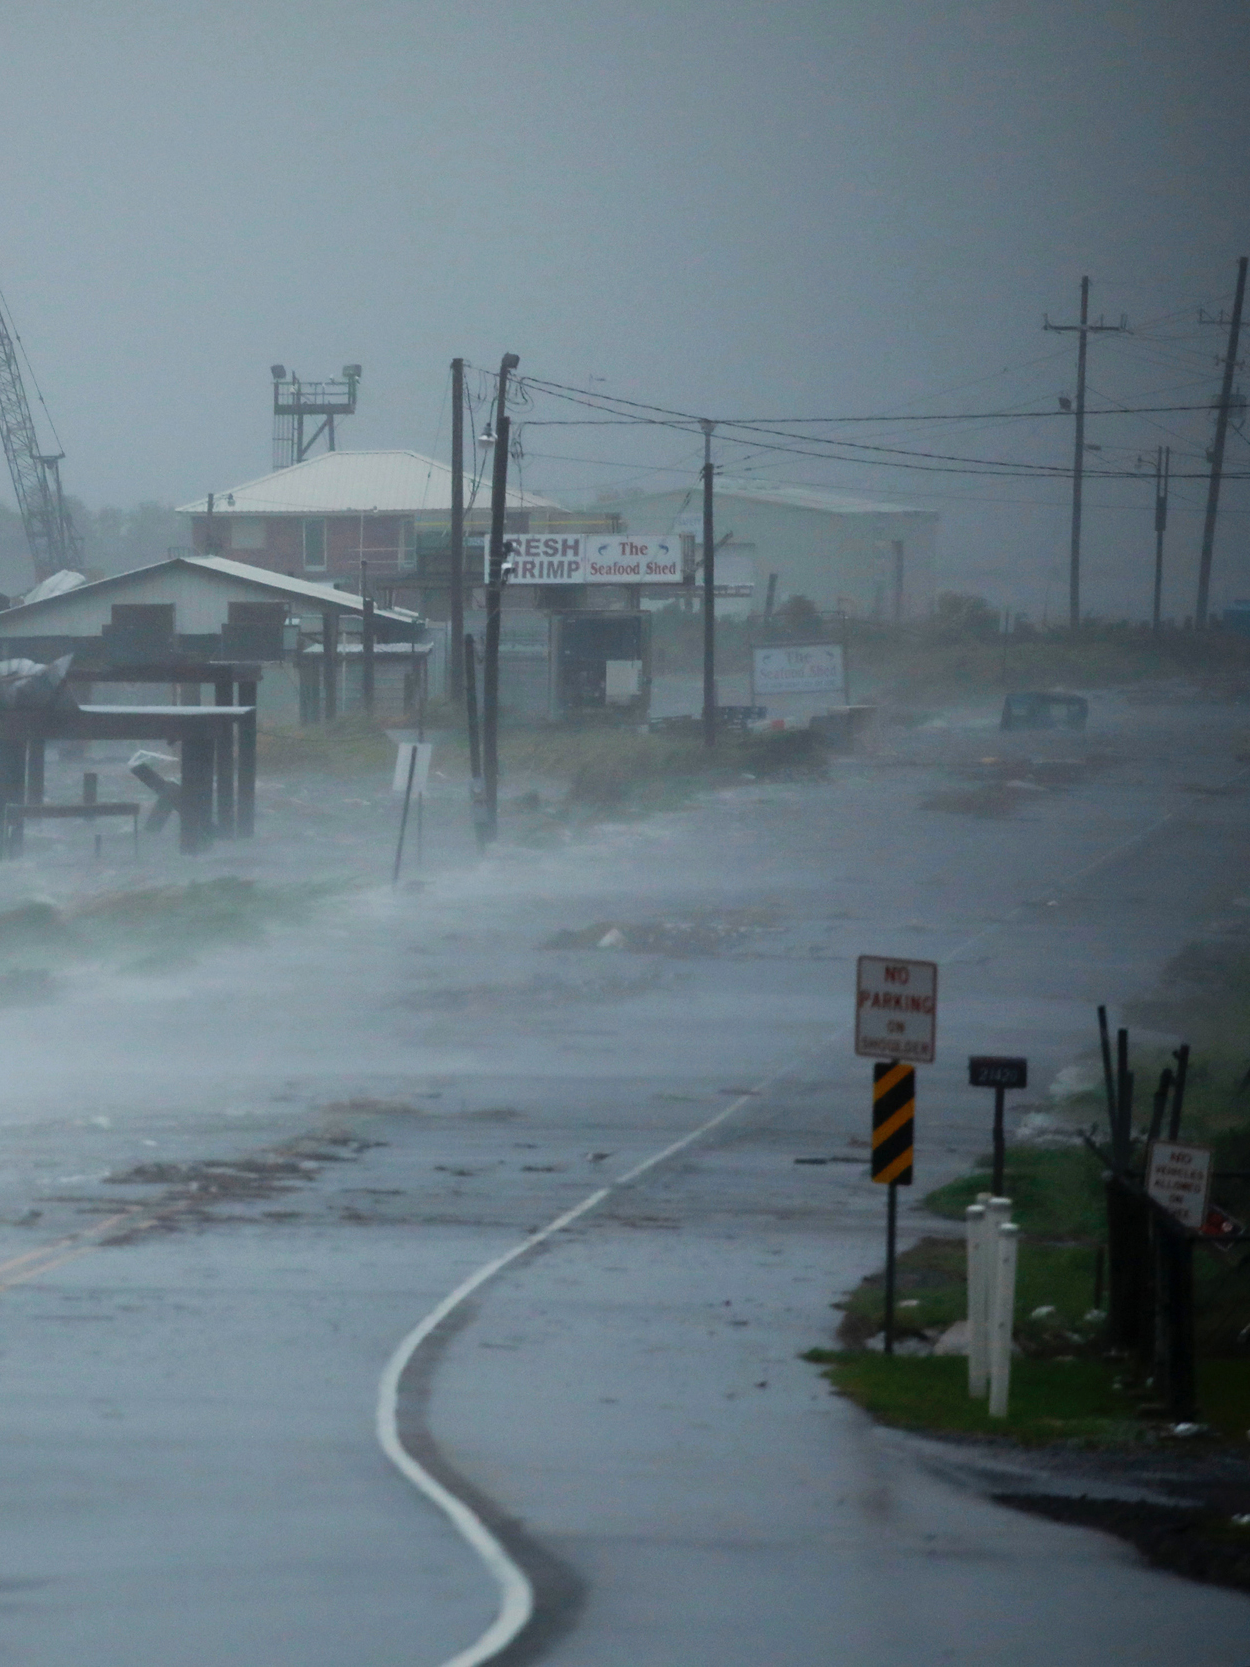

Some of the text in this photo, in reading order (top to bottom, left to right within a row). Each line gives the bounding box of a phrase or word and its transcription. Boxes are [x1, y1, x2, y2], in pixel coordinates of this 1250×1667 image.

[506, 538, 580, 557] RESH
[619, 542, 649, 556] The
[590, 561, 676, 576] Seafood Shed
[884, 965, 910, 985] NO
[857, 990, 934, 1014] PARKING
[1170, 1152, 1192, 1164] NO
